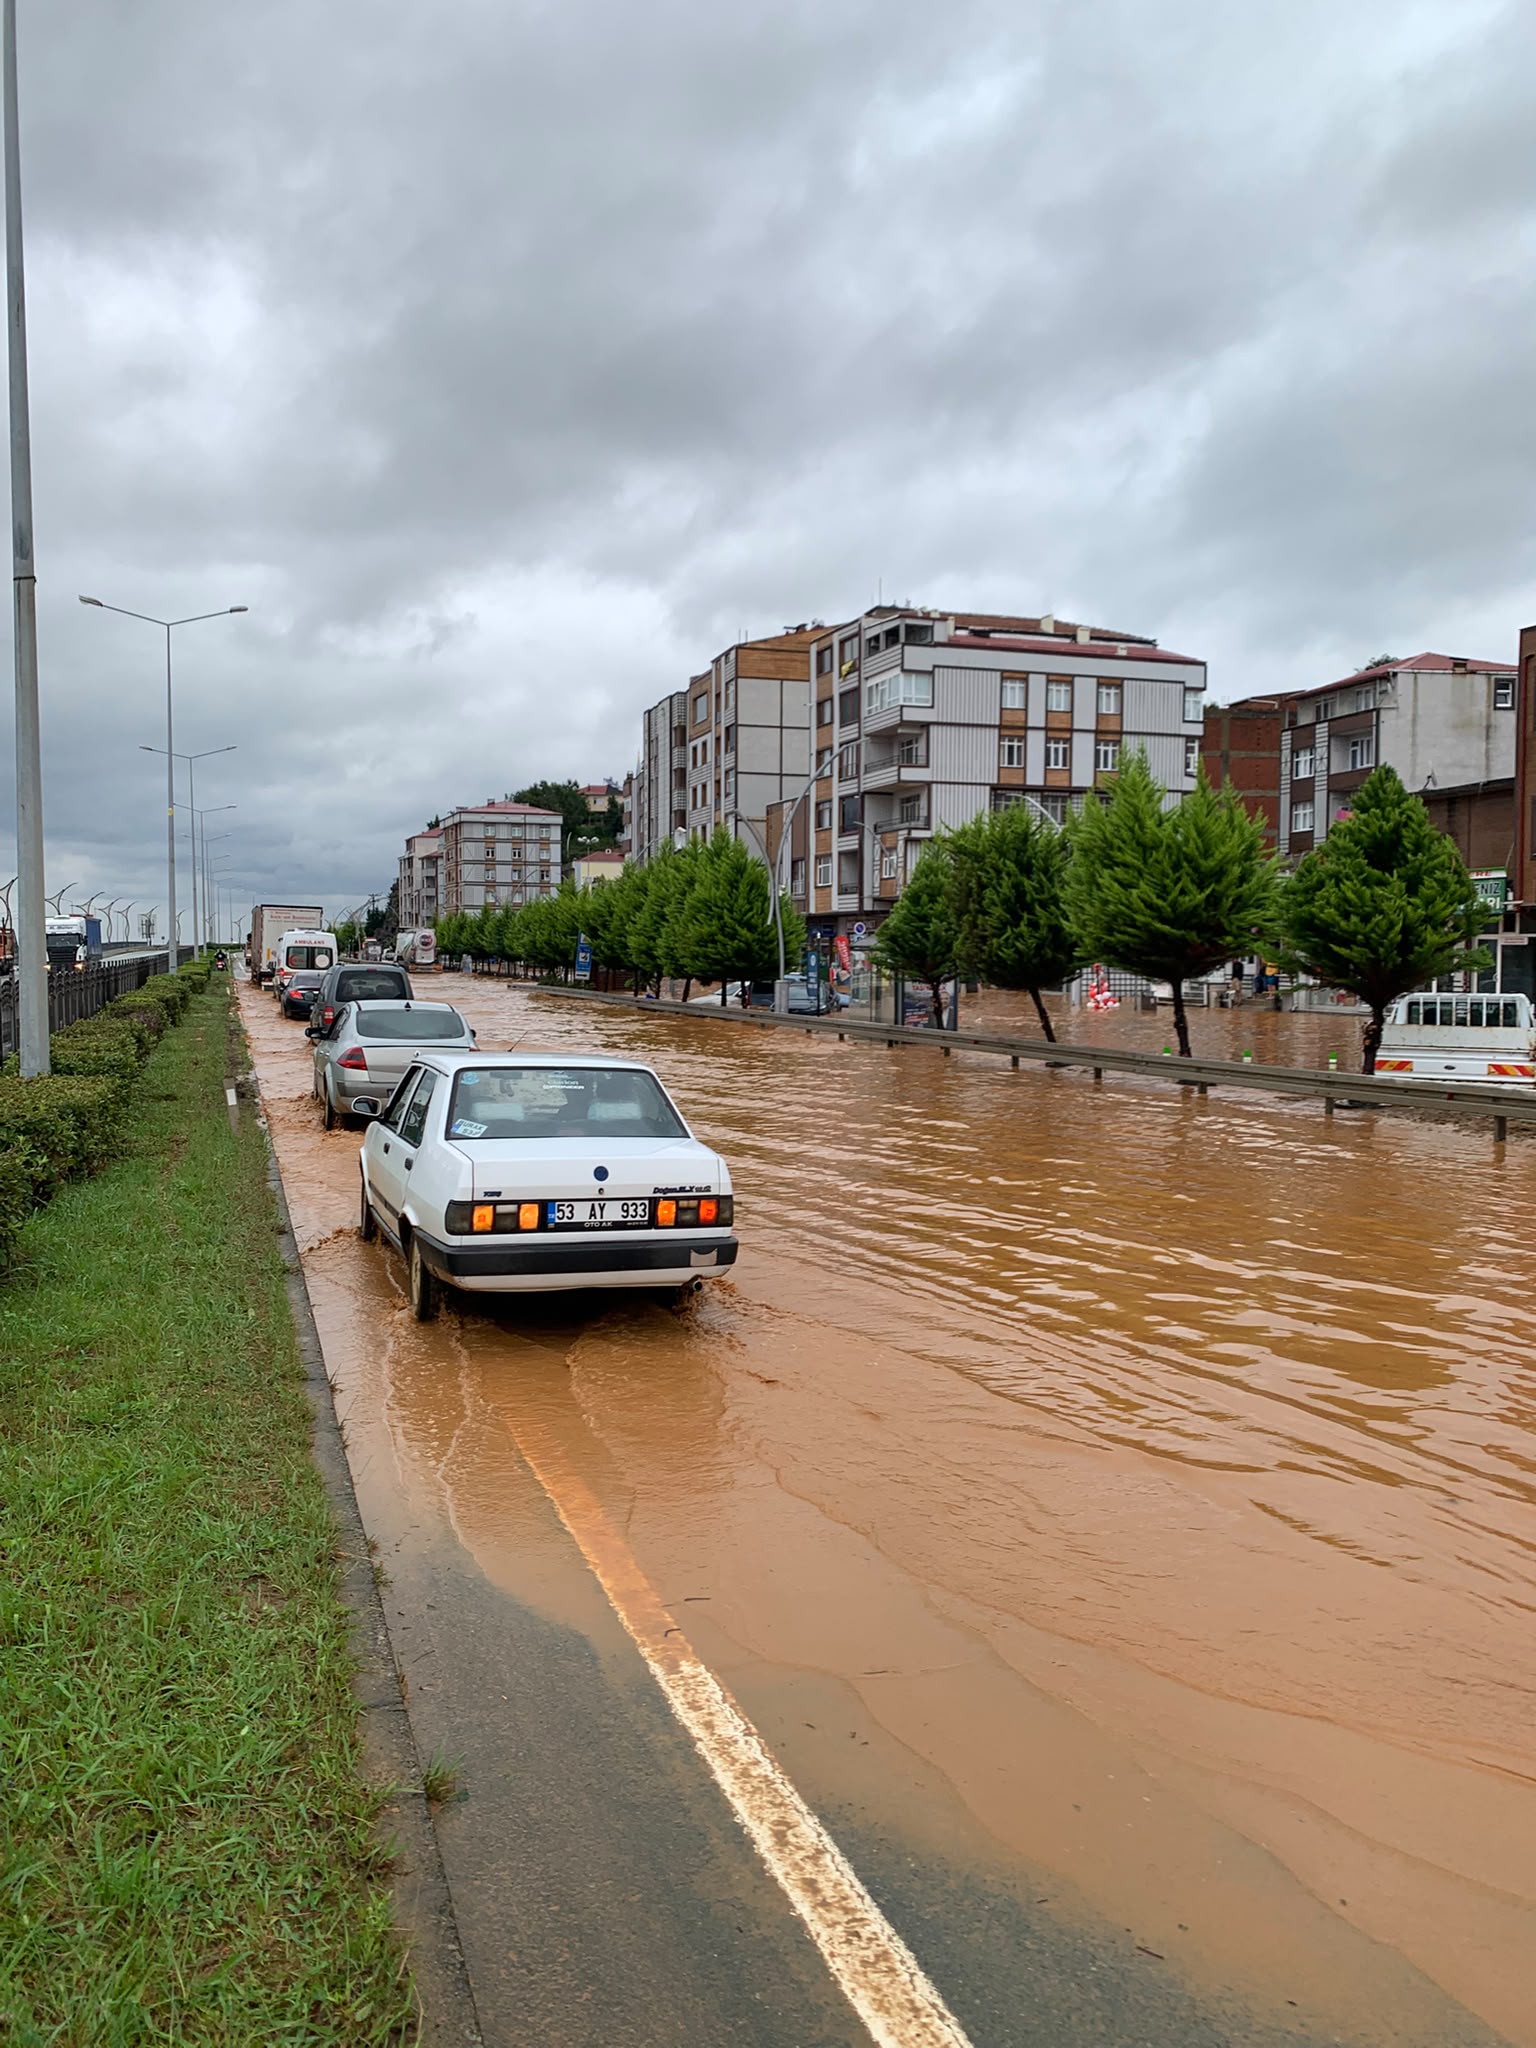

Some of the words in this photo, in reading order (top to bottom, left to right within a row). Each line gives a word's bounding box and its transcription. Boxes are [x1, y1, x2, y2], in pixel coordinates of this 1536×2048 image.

[556, 1203, 575, 1221] 53
[588, 1202, 607, 1220] AY
[621, 1202, 648, 1219] 933
